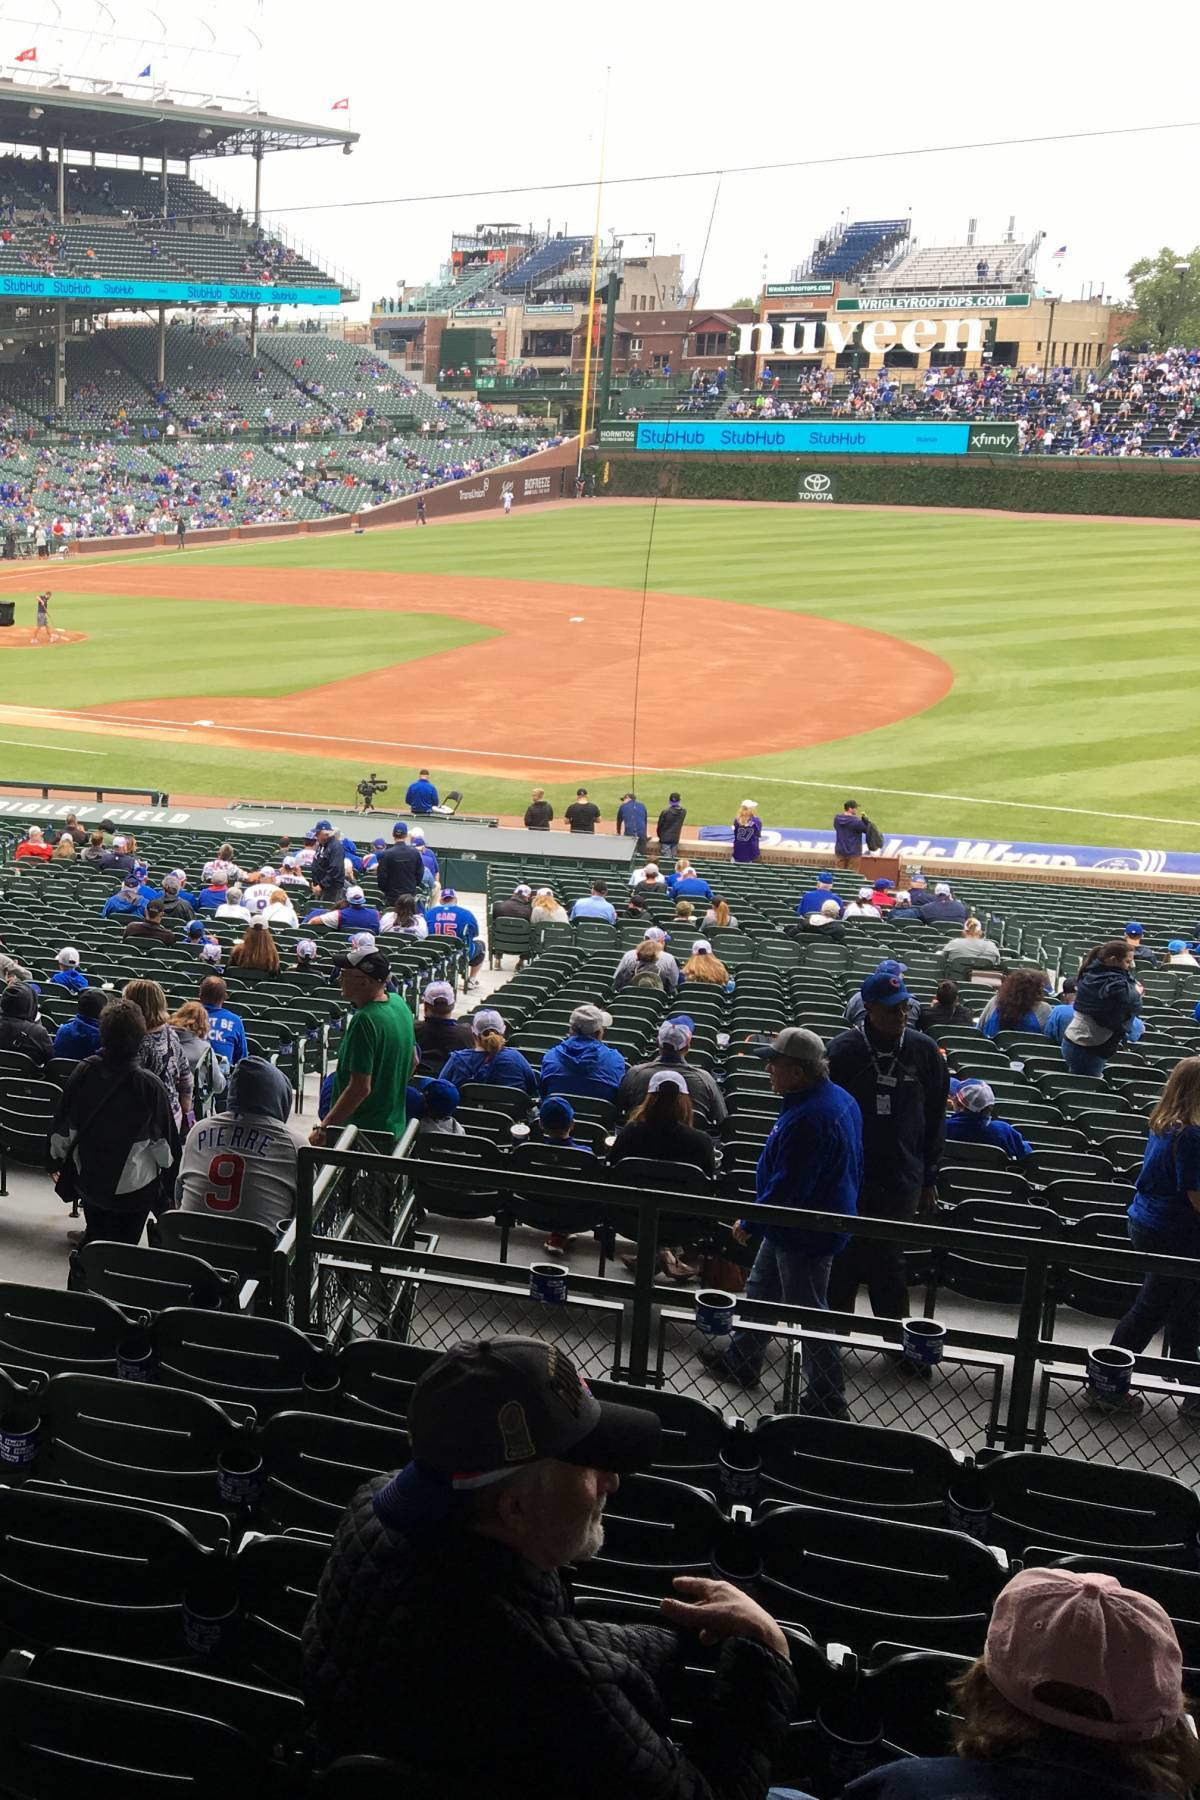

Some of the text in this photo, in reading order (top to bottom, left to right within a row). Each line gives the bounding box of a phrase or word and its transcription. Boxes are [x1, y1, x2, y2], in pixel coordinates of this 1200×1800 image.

[3, 278, 298, 301] StubHub StubHub StubHub StubHub StubHub StubHub
[768, 284, 831, 293] WRIGLEYROOFTOPS.COM
[858, 295, 1007, 310] WRIGLEYROOFTOPS.COM
[734, 317, 985, 356] nuveen
[600, 430, 634, 438] HORNITOS
[640, 429, 866, 445] StubHub StubHub StubHub
[971, 432, 1016, 448] xfinity
[798, 492, 833, 501] TOYOTA
[102, 807, 192, 824] FIELD
[737, 827, 754, 841] 27
[434, 922, 458, 937] 15
[220, 1018, 234, 1032] BE
[198, 1125, 275, 1158] PIERRE
[204, 1152, 247, 1213] 9
